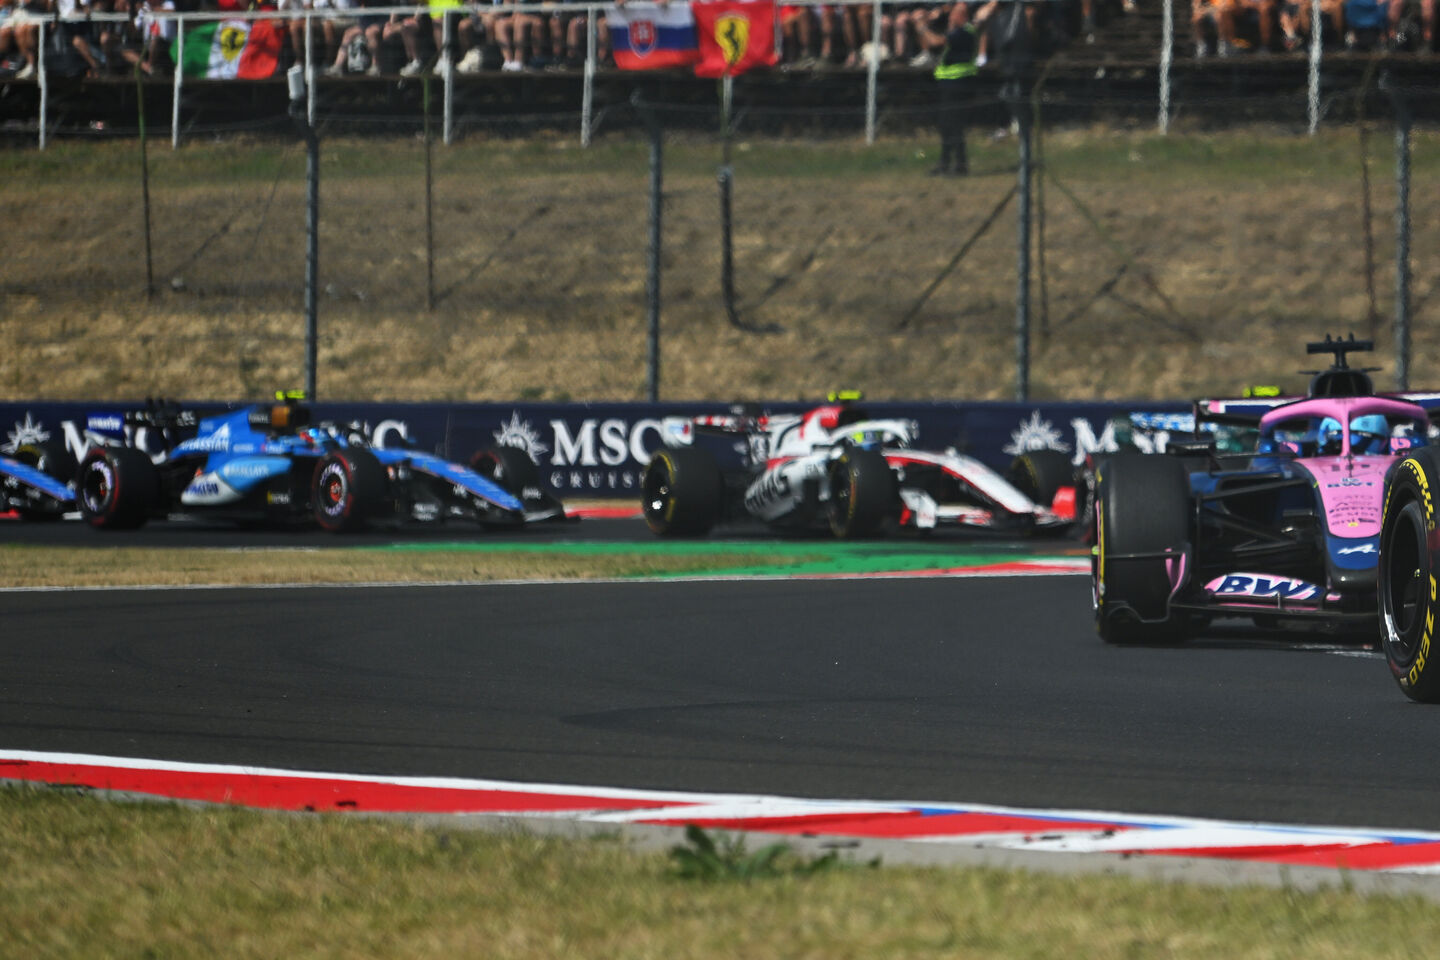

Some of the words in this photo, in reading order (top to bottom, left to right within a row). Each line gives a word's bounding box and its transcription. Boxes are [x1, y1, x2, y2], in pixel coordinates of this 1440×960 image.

[549, 417, 664, 466] MSC
[1429, 573, 1438, 603] P
[1409, 605, 1435, 686] ZERO
